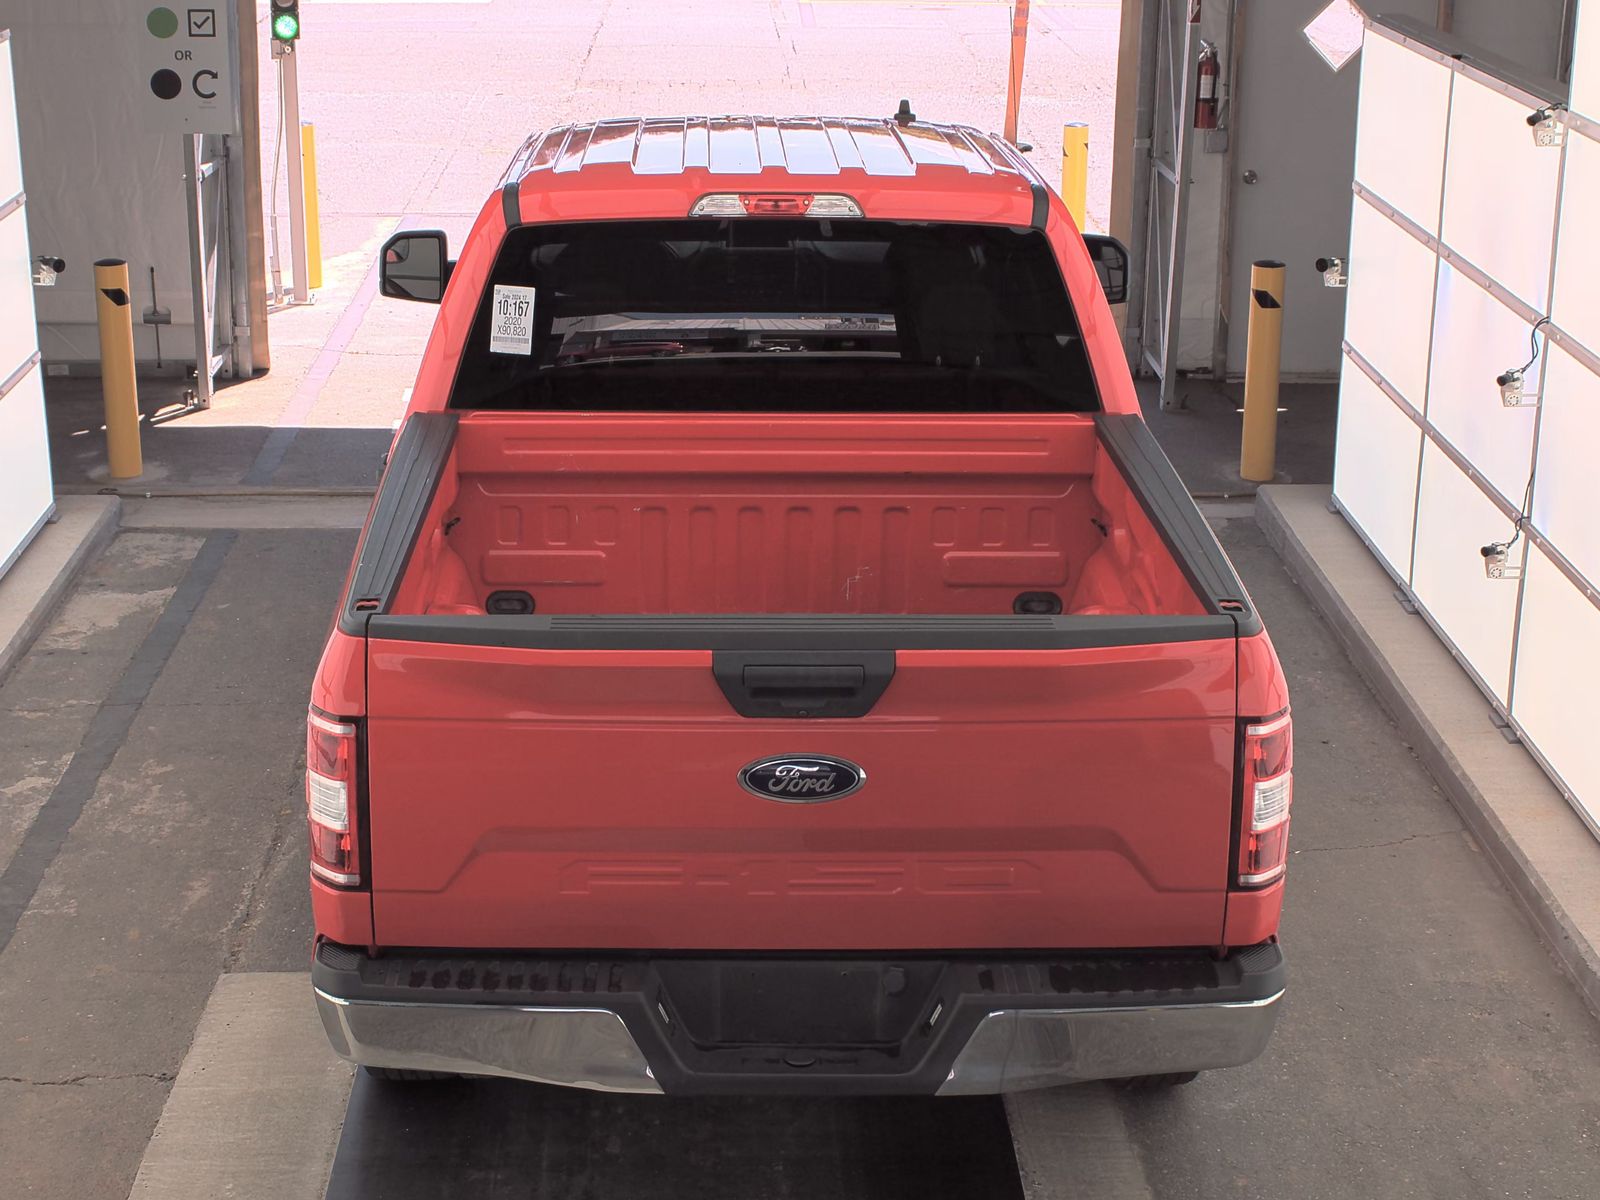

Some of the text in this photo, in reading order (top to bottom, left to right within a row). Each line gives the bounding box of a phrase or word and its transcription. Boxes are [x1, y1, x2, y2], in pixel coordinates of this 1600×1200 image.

[174, 50, 192, 60] OR
[498, 299, 530, 317] 10:167
[504, 316, 522, 325] 2020
[497, 325, 527, 336] X90,820
[768, 764, 836, 792] Ford
[558, 859, 1041, 895] F-150
